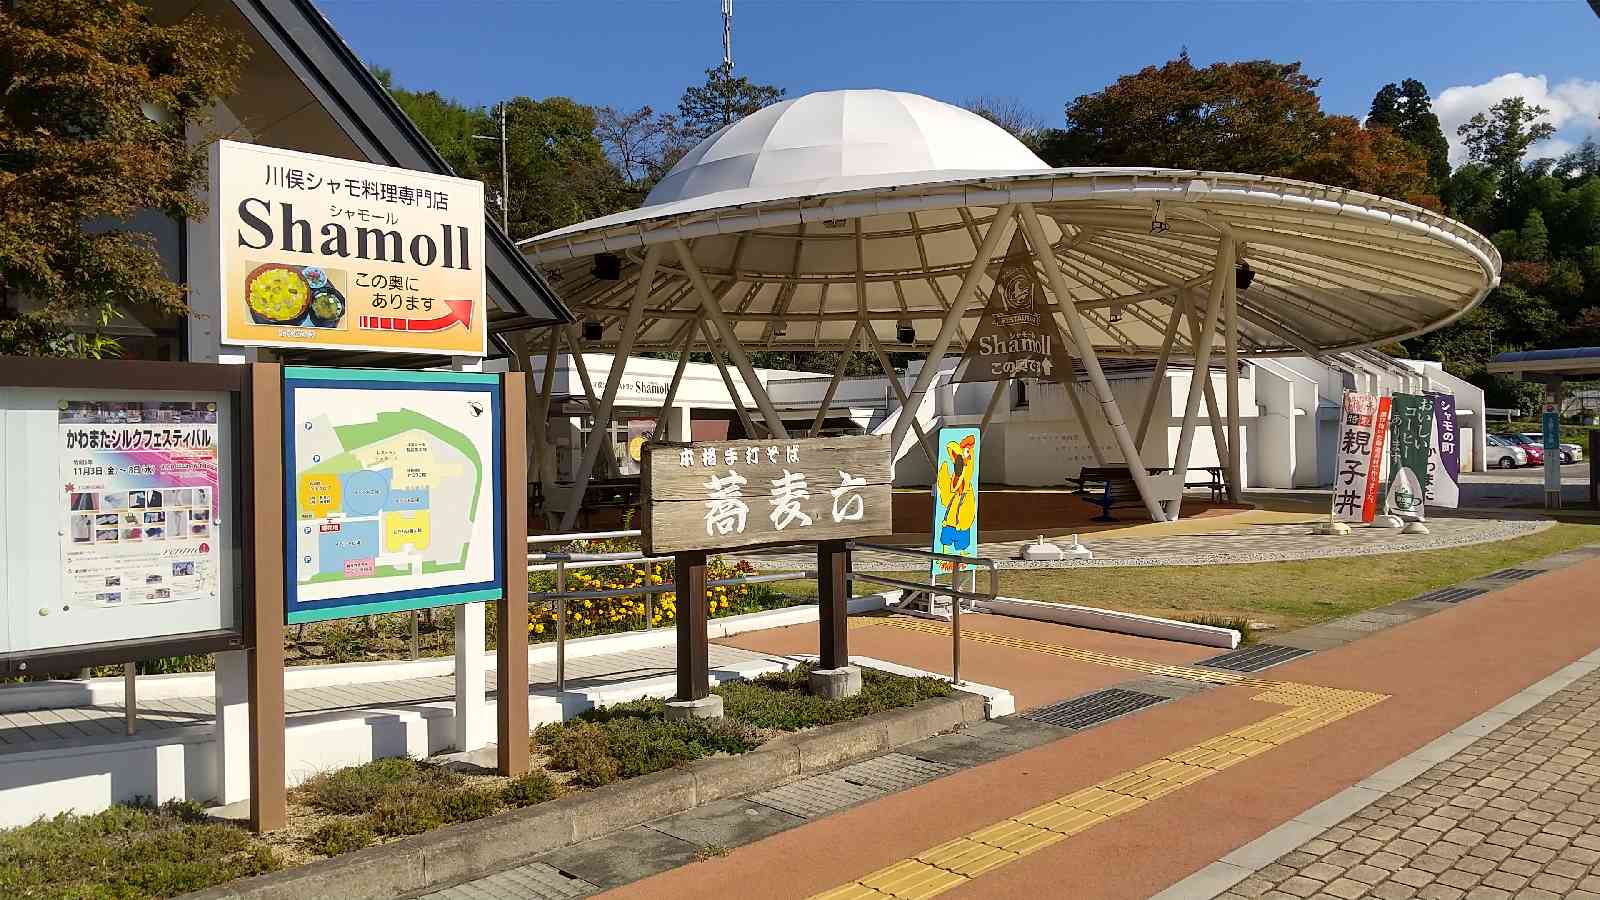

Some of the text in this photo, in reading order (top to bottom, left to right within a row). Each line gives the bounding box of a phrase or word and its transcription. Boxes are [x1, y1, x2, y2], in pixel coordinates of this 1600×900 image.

[265, 164, 449, 211] 川俣シャモ料理専門店
[329, 204, 399, 226] シャモール
[238, 197, 473, 271] Shamoll
[355, 272, 420, 292] この奥に
[371, 294, 436, 312] あります
[979, 335, 1051, 356] Shamoll
[635, 380, 670, 395] Shamoll
[1403, 407, 1417, 459] コーヒー
[1415, 398, 1433, 449] おいしい
[1441, 400, 1455, 454] シャモの町
[66, 428, 212, 450] かわまたシルクフェスティバル
